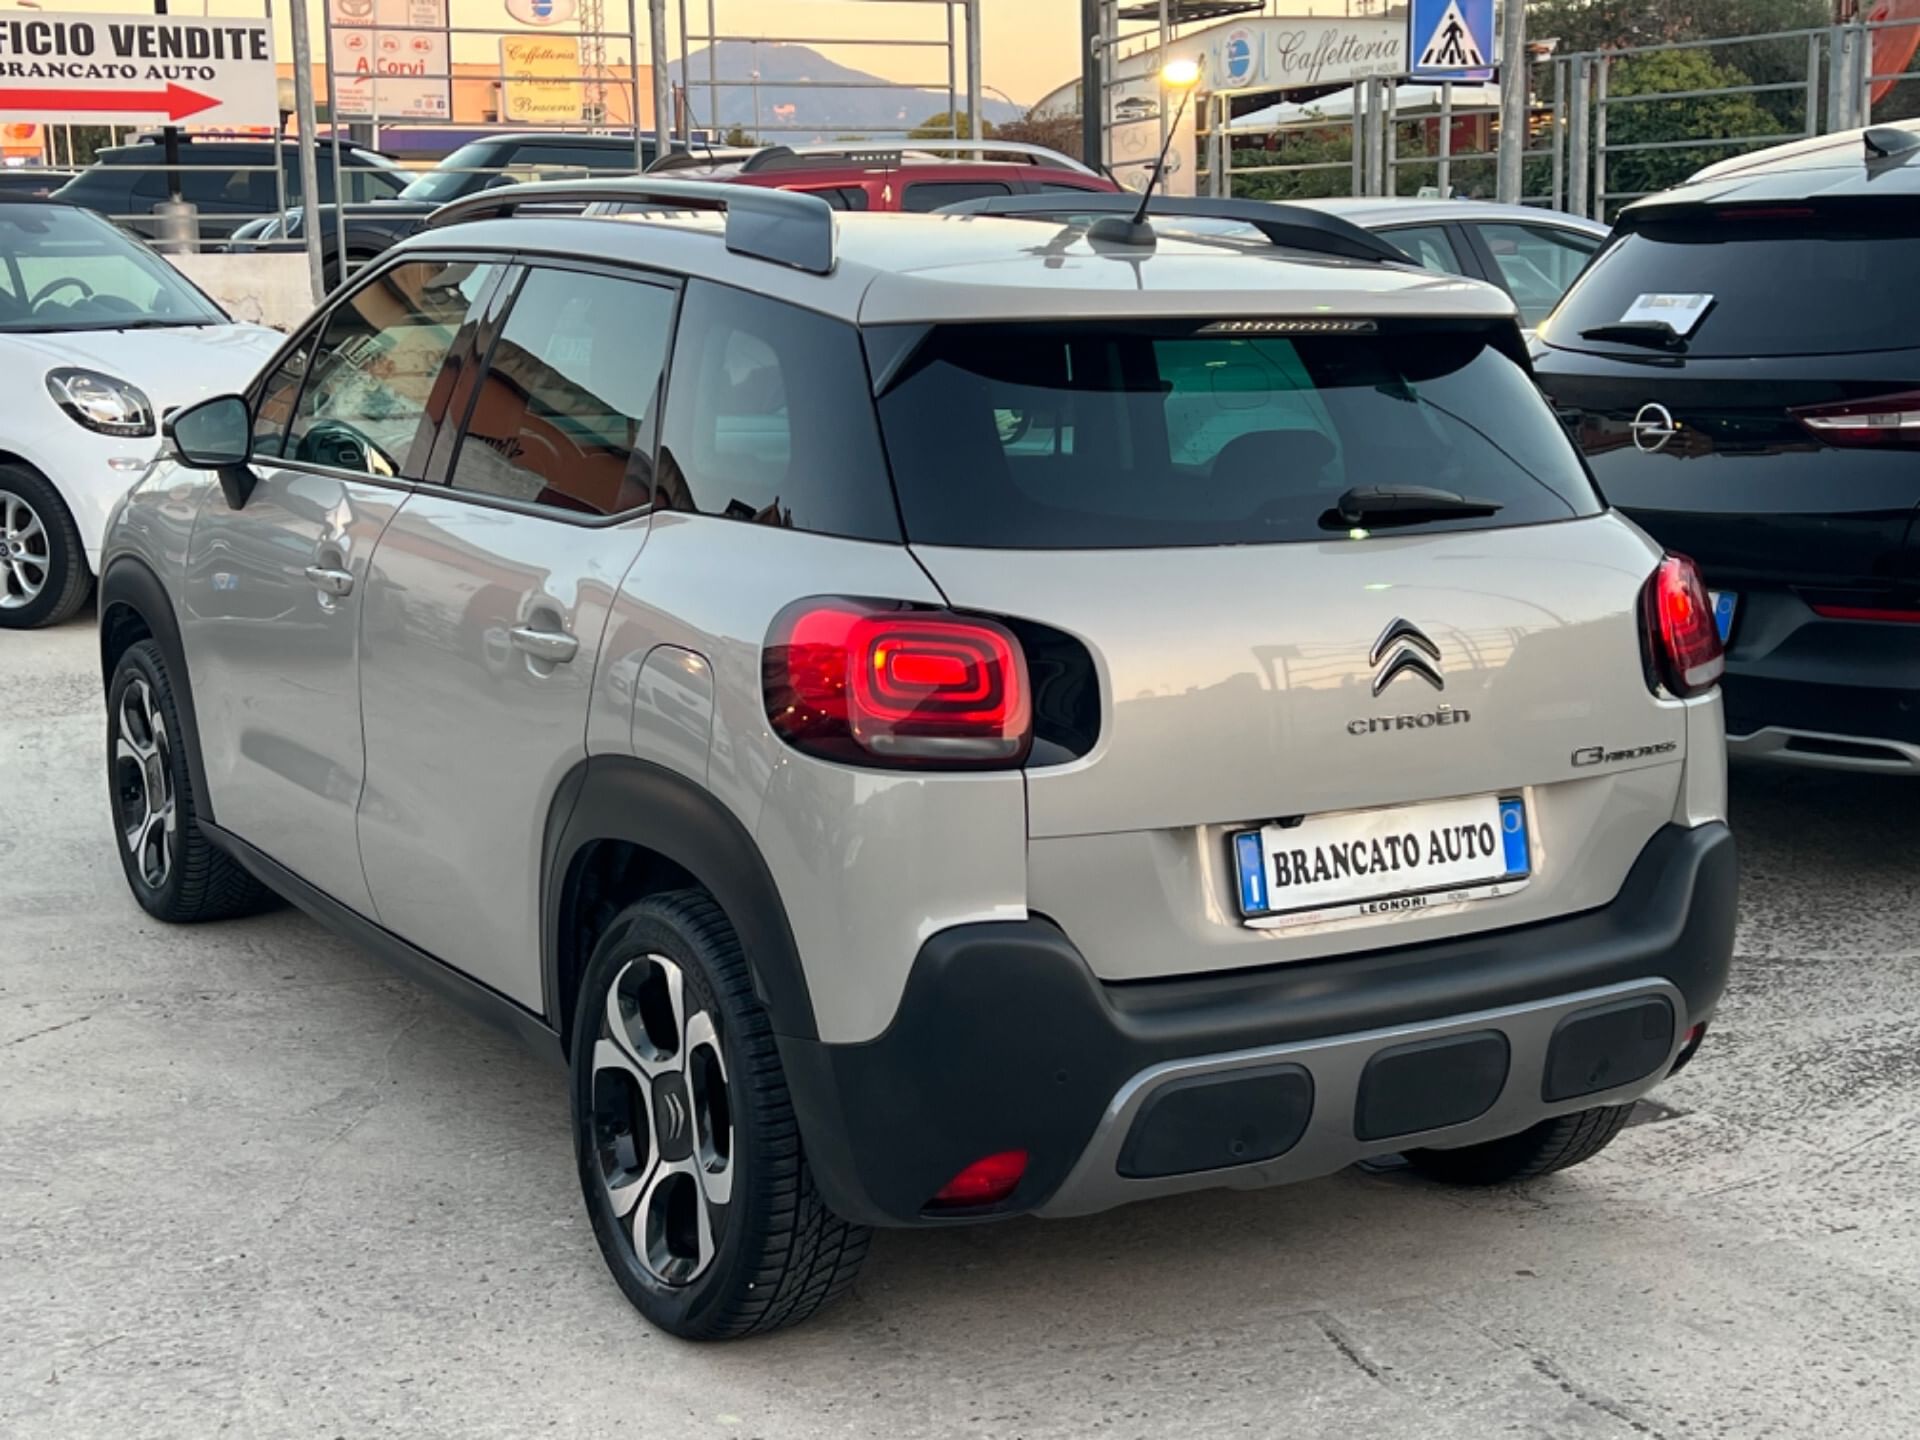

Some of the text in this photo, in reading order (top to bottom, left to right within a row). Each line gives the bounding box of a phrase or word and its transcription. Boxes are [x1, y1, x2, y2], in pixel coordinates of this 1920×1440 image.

[109, 24, 268, 61] VENDITE
[1278, 28, 1400, 83] Caffetteria
[144, 65, 216, 81] AUTO
[377, 58, 425, 76] Corvi
[1272, 822, 1496, 888] BRANCATO AUTO
[1359, 896, 1427, 915] LEONORI
